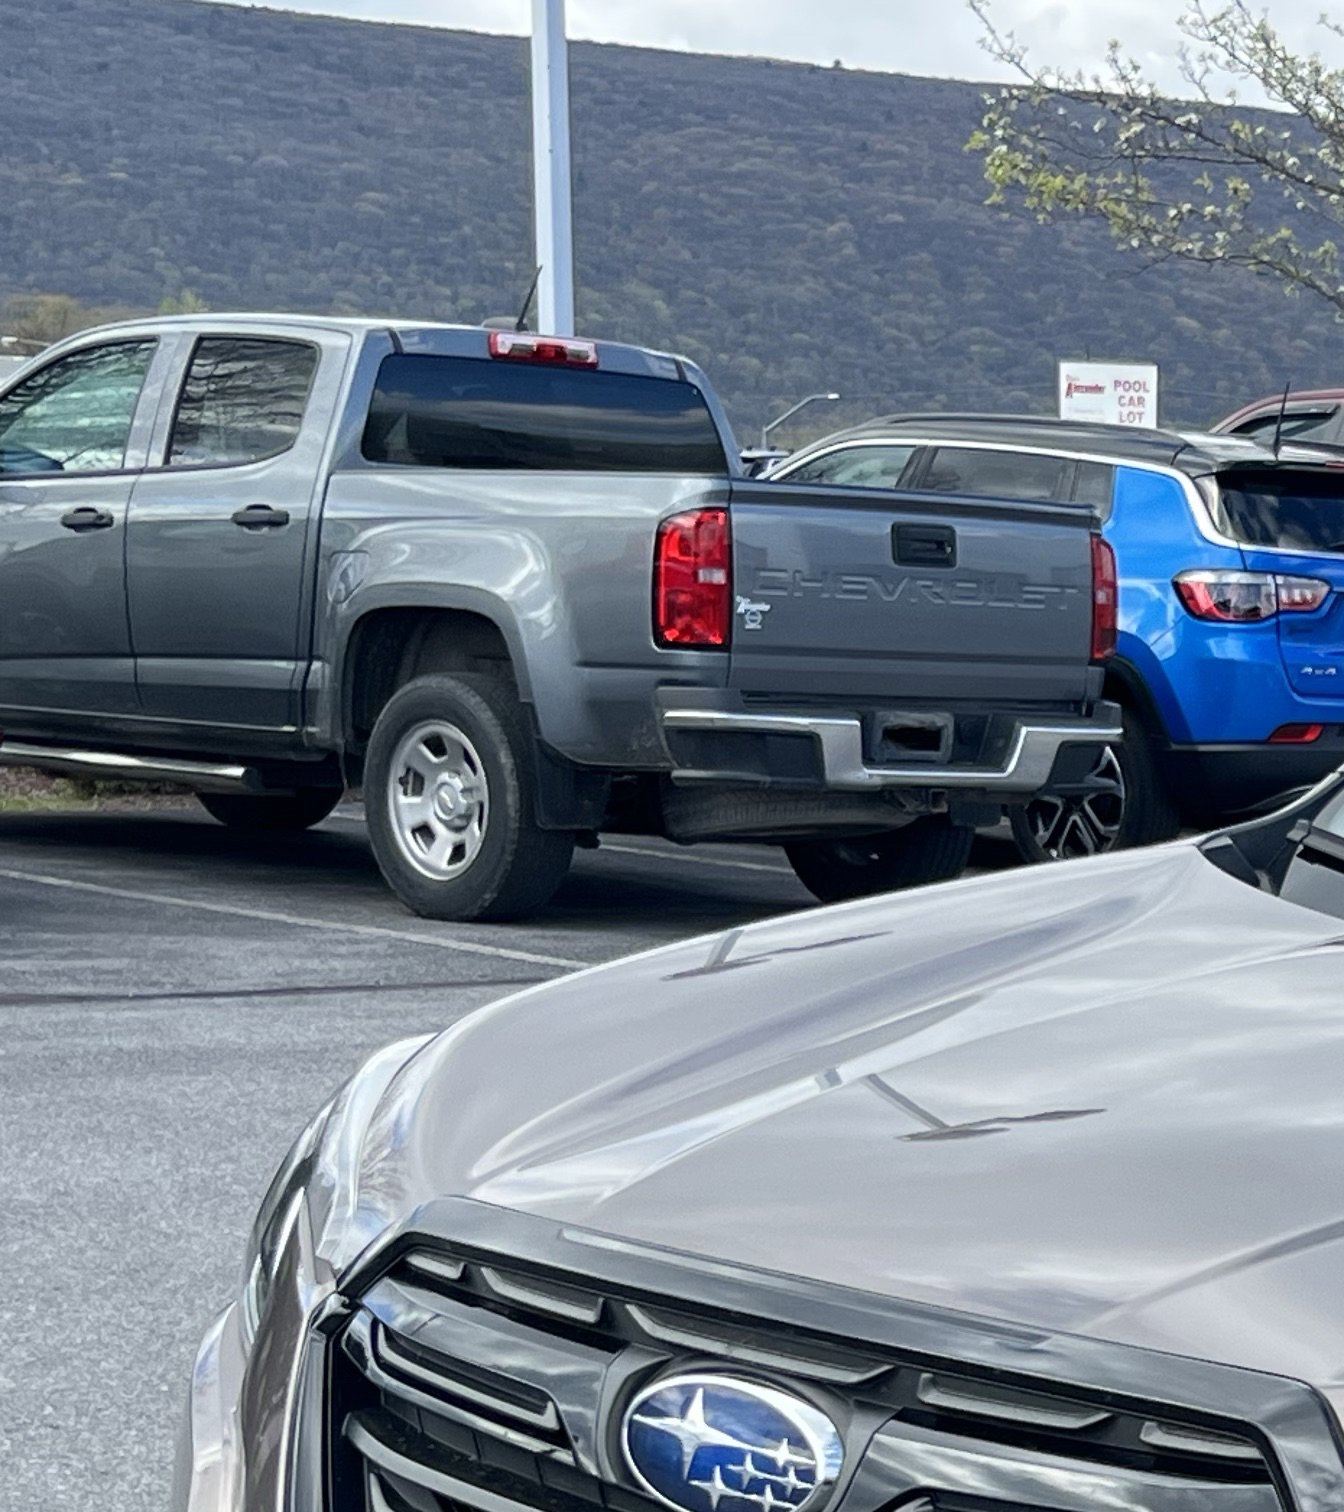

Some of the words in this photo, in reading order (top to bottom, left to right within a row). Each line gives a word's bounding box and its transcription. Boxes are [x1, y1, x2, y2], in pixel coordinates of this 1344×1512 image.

[1113, 380, 1150, 393] POOL
[1118, 395, 1146, 408] CAR
[1119, 411, 1145, 424] LOT
[752, 568, 1080, 610] CHEVROLET
